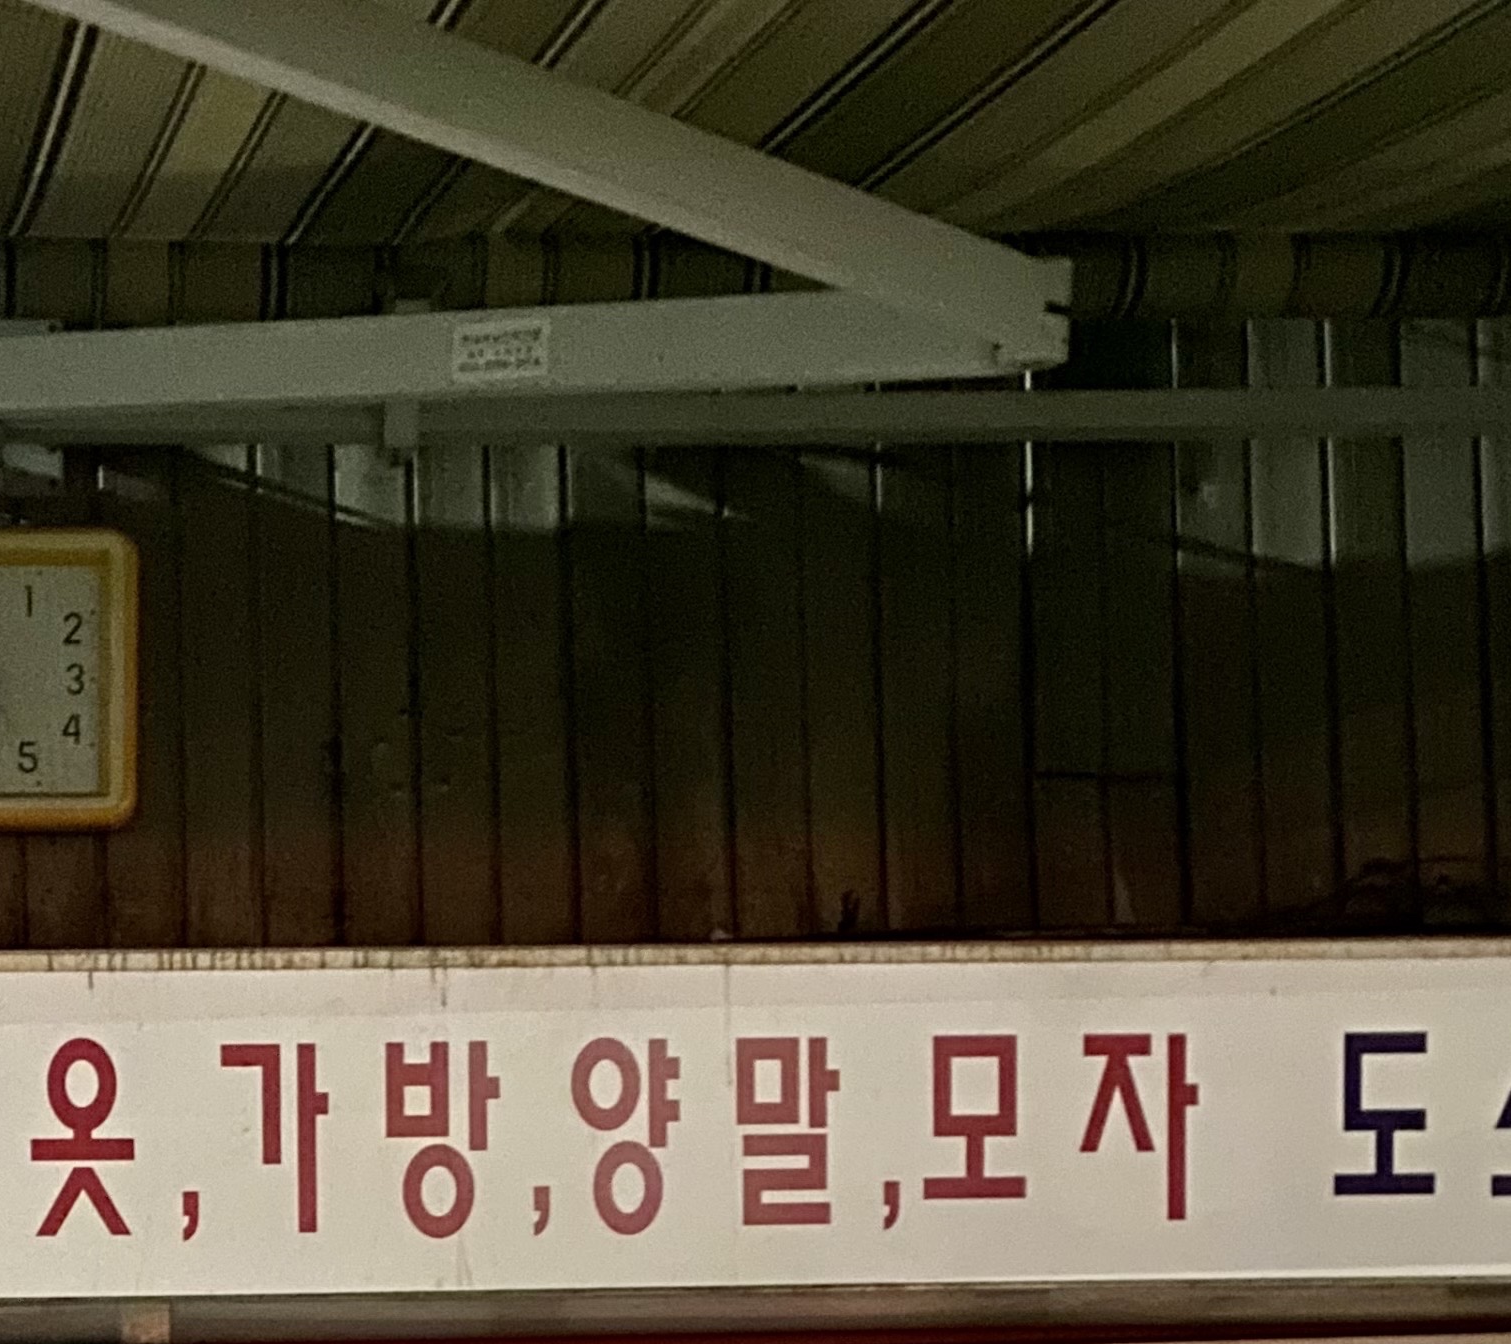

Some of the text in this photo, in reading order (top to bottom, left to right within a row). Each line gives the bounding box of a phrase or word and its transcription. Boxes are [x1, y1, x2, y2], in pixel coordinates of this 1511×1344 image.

[24, 584, 33, 617] 1
[62, 612, 83, 645] 2
[66, 663, 85, 695] 3
[62, 713, 81, 744] 4
[18, 741, 38, 773] 5
[1333, 1031, 1511, 1197] 도
